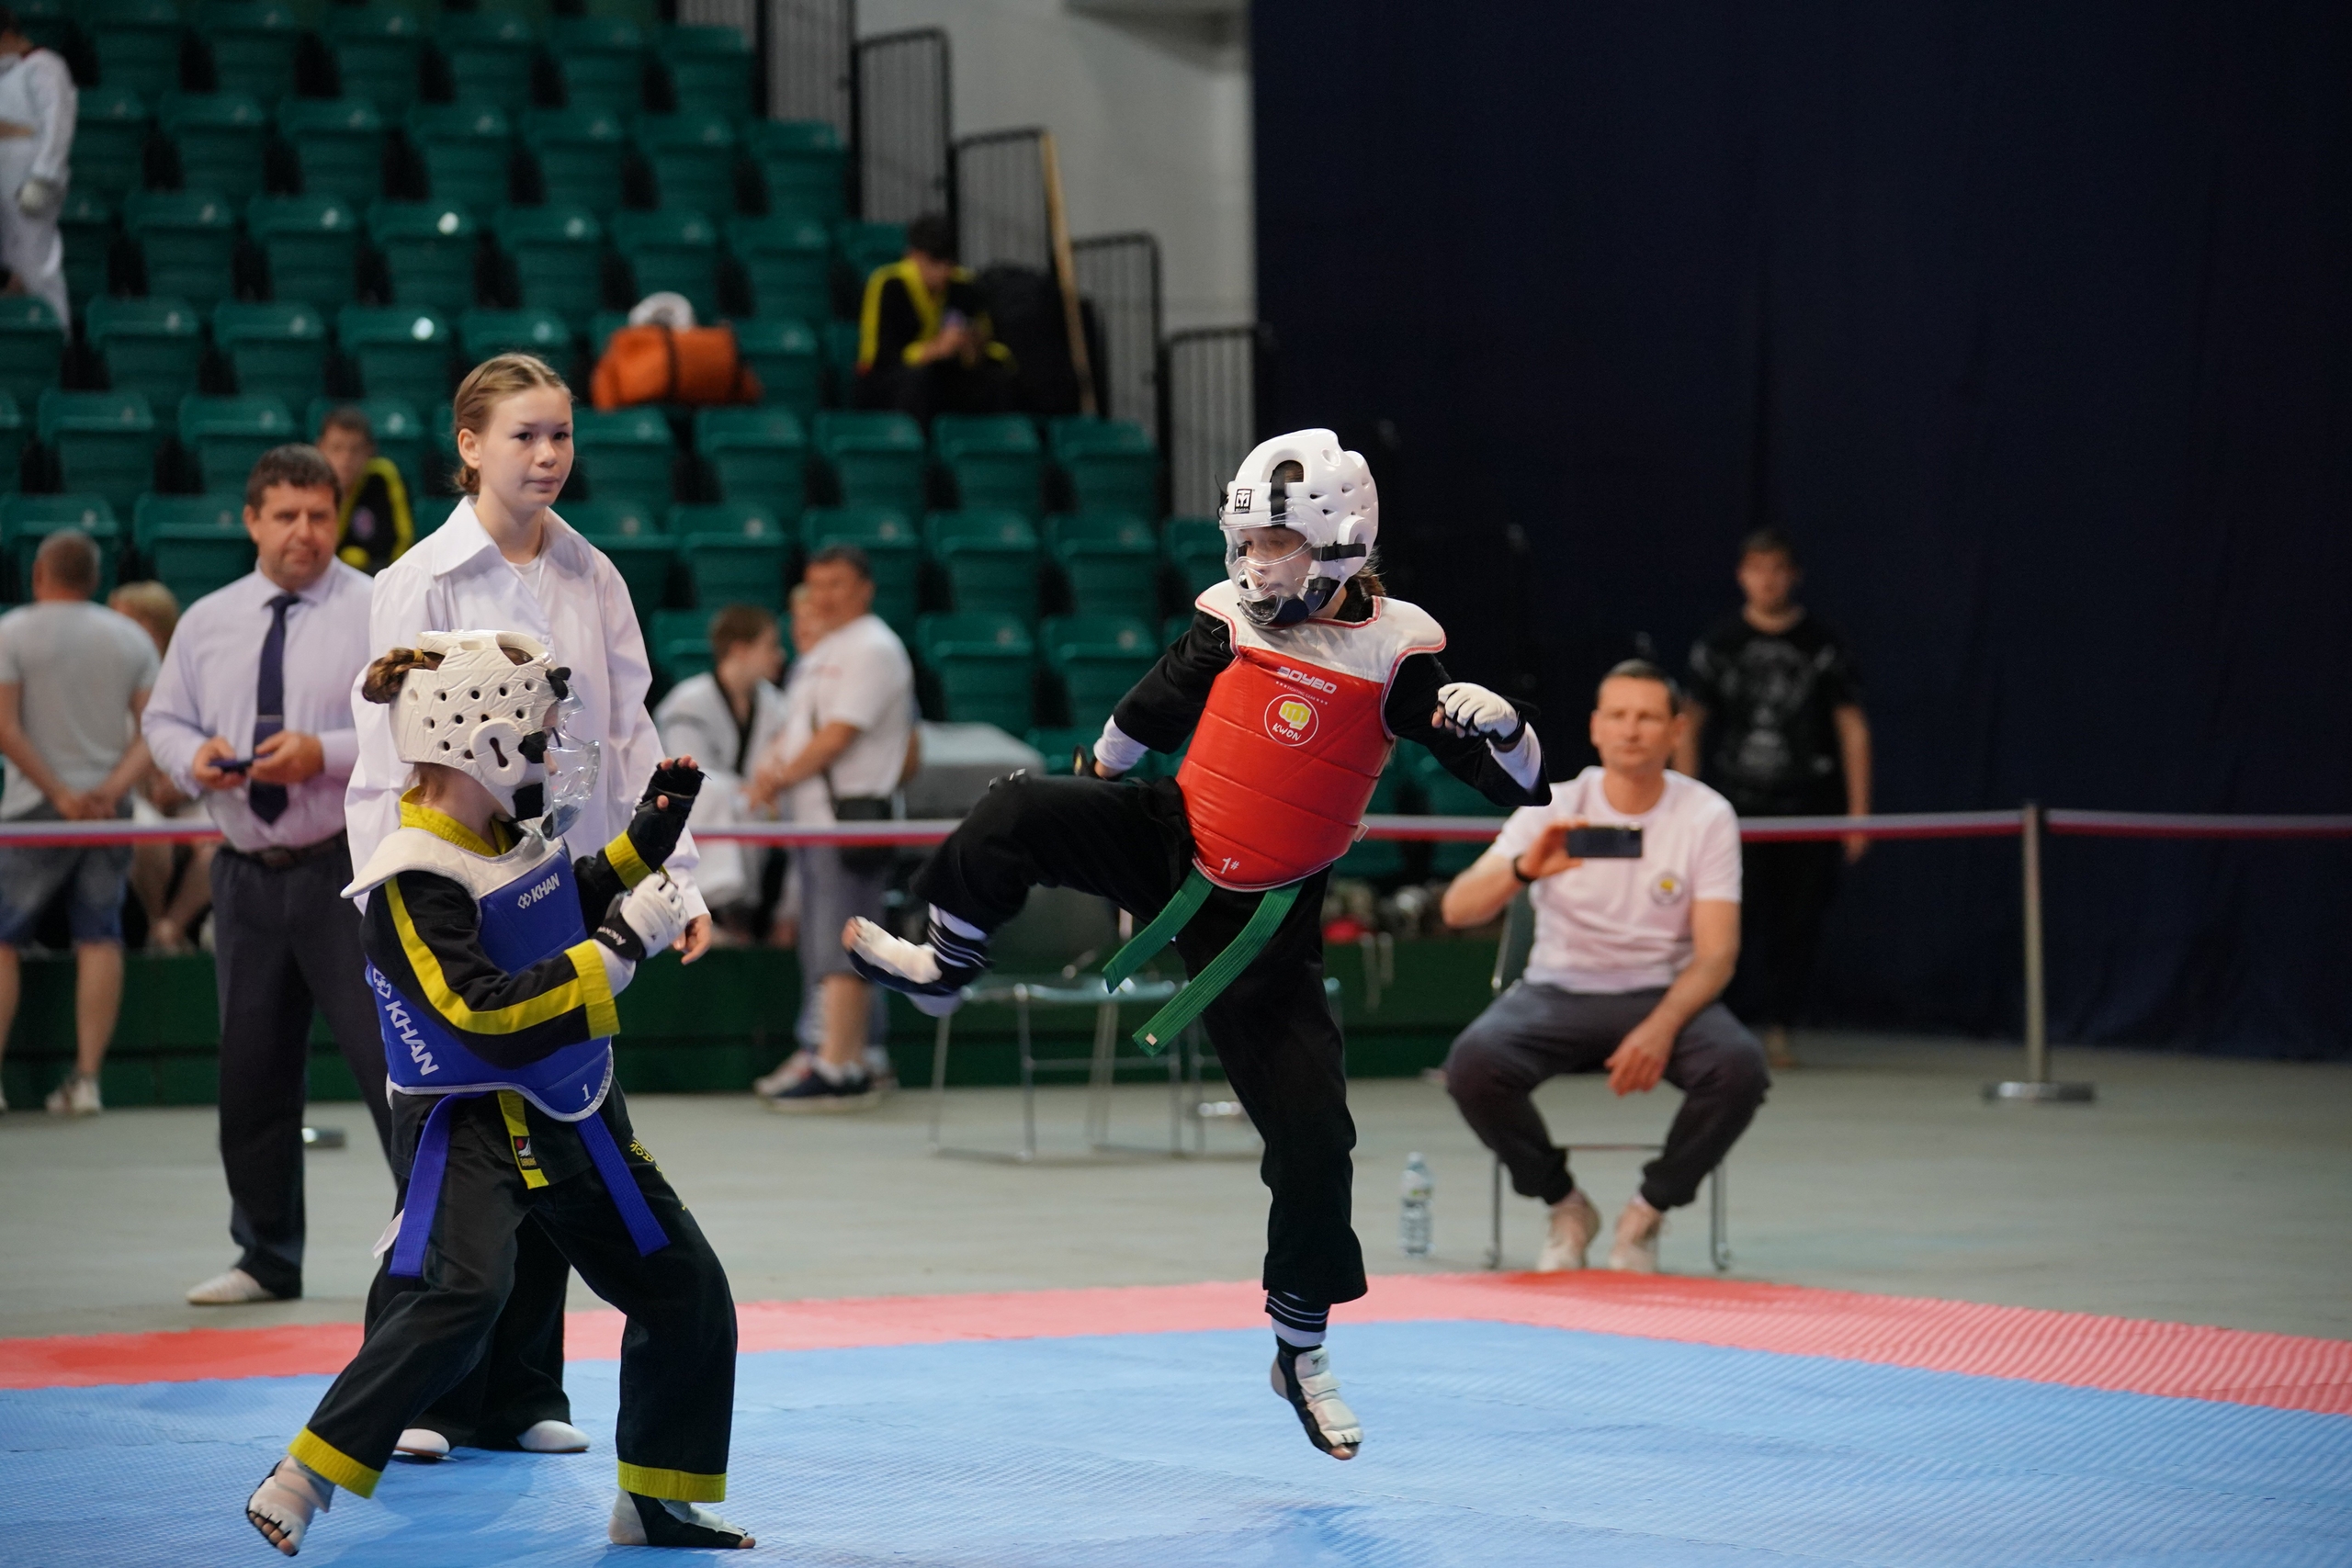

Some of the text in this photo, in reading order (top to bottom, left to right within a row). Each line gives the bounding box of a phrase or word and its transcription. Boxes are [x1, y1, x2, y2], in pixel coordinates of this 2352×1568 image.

[1272, 722, 1302, 741] KWON
[530, 873, 560, 903] KHAN
[385, 1000, 439, 1076] KHAN
[582, 1083, 592, 1102] 1
